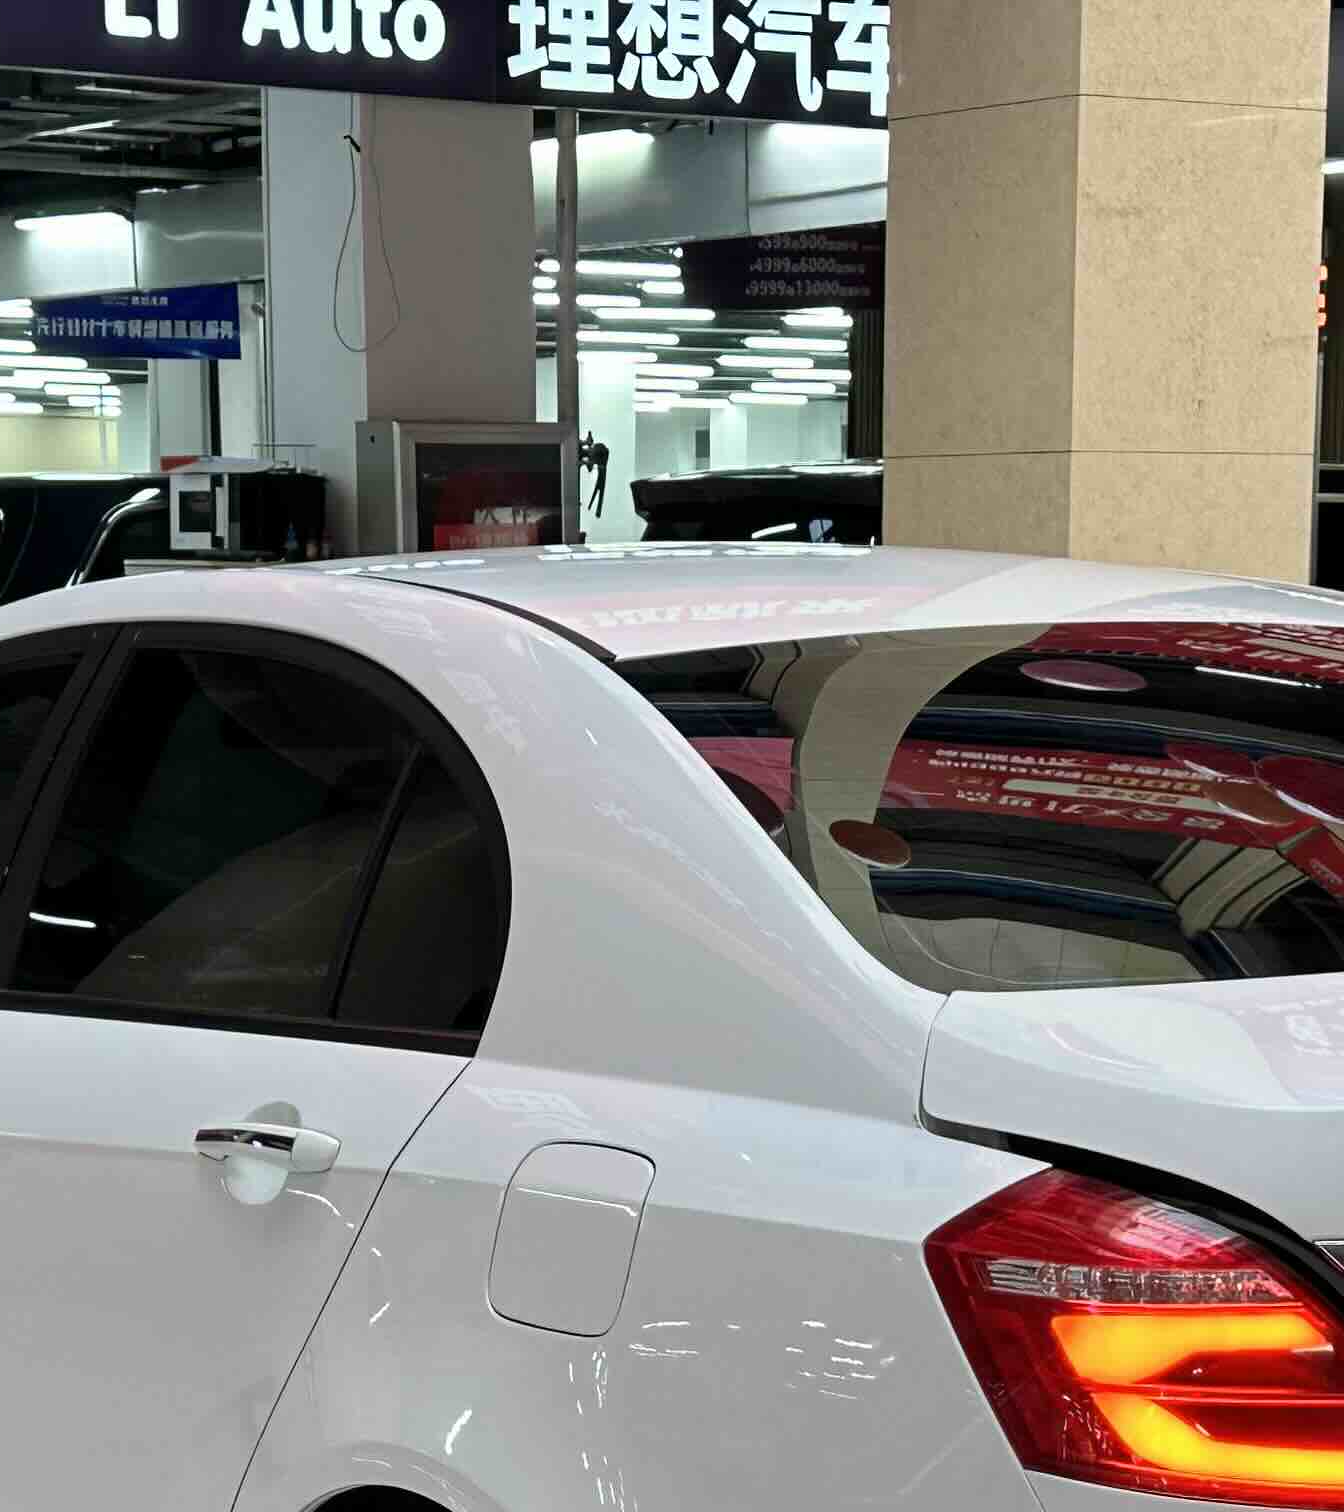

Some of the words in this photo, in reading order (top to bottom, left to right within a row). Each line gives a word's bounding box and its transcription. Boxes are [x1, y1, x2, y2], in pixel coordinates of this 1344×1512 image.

[241, 0, 447, 61] Auto
[507, 0, 889, 117] 理想汽车
